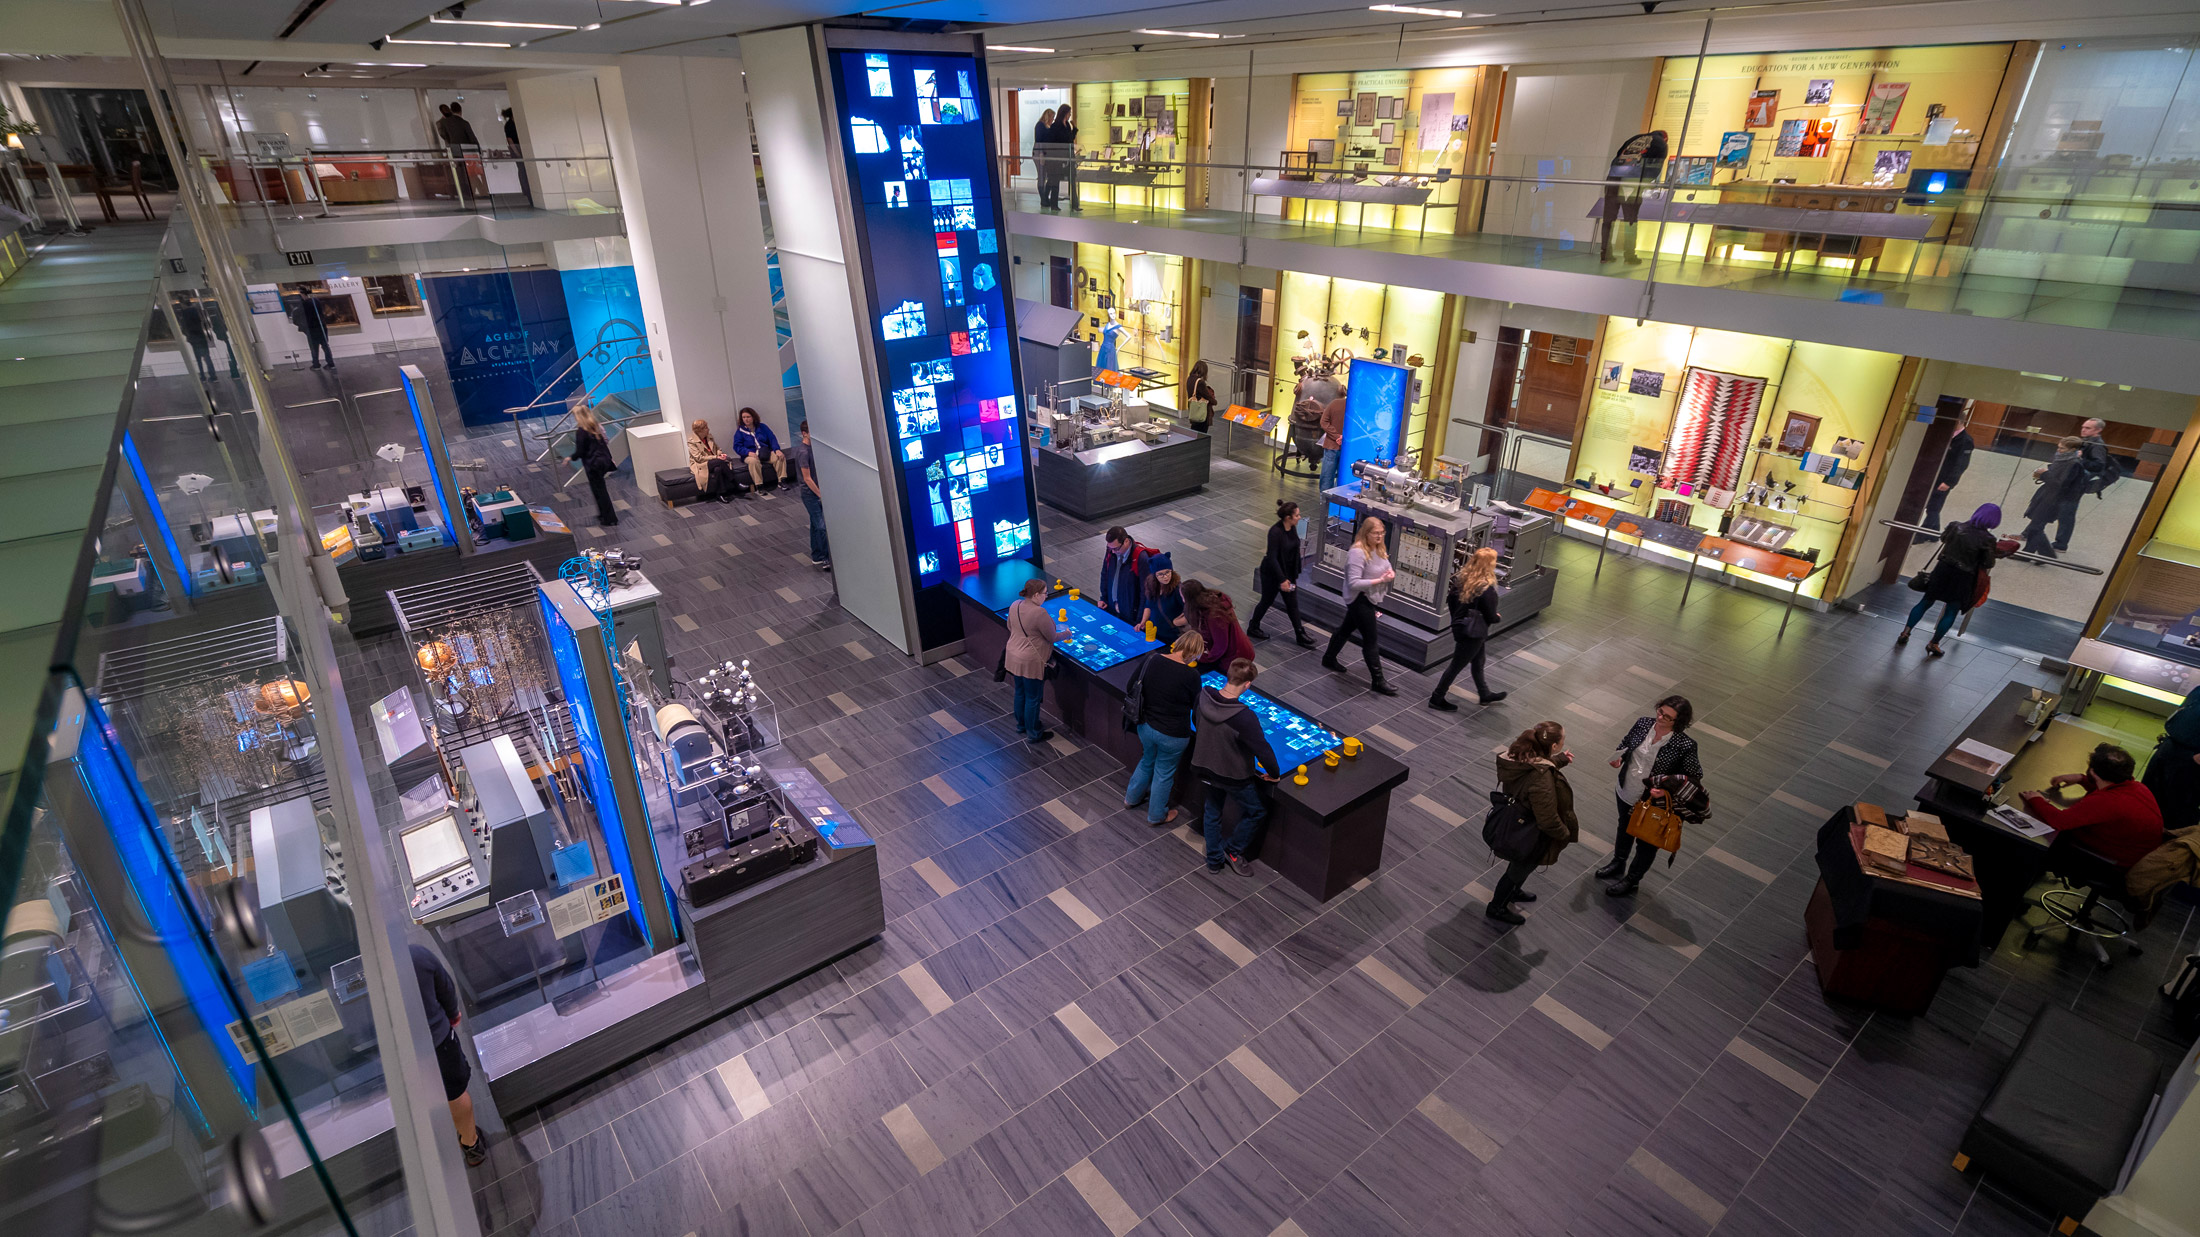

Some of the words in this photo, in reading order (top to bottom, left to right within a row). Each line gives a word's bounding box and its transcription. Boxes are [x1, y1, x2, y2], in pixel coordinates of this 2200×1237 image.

[1741, 64, 1788, 73] EDUCATION
[1791, 63, 1807, 71] FOR
[1809, 63, 1815, 71] A
[1818, 62, 1840, 70] NEW
[1840, 60, 1900, 70] GENERATION
[289, 251, 312, 266] EXIT
[329, 280, 360, 290] GALLERY
[485, 332, 510, 343] AGE
[460, 339, 560, 366] ALCHEMY
